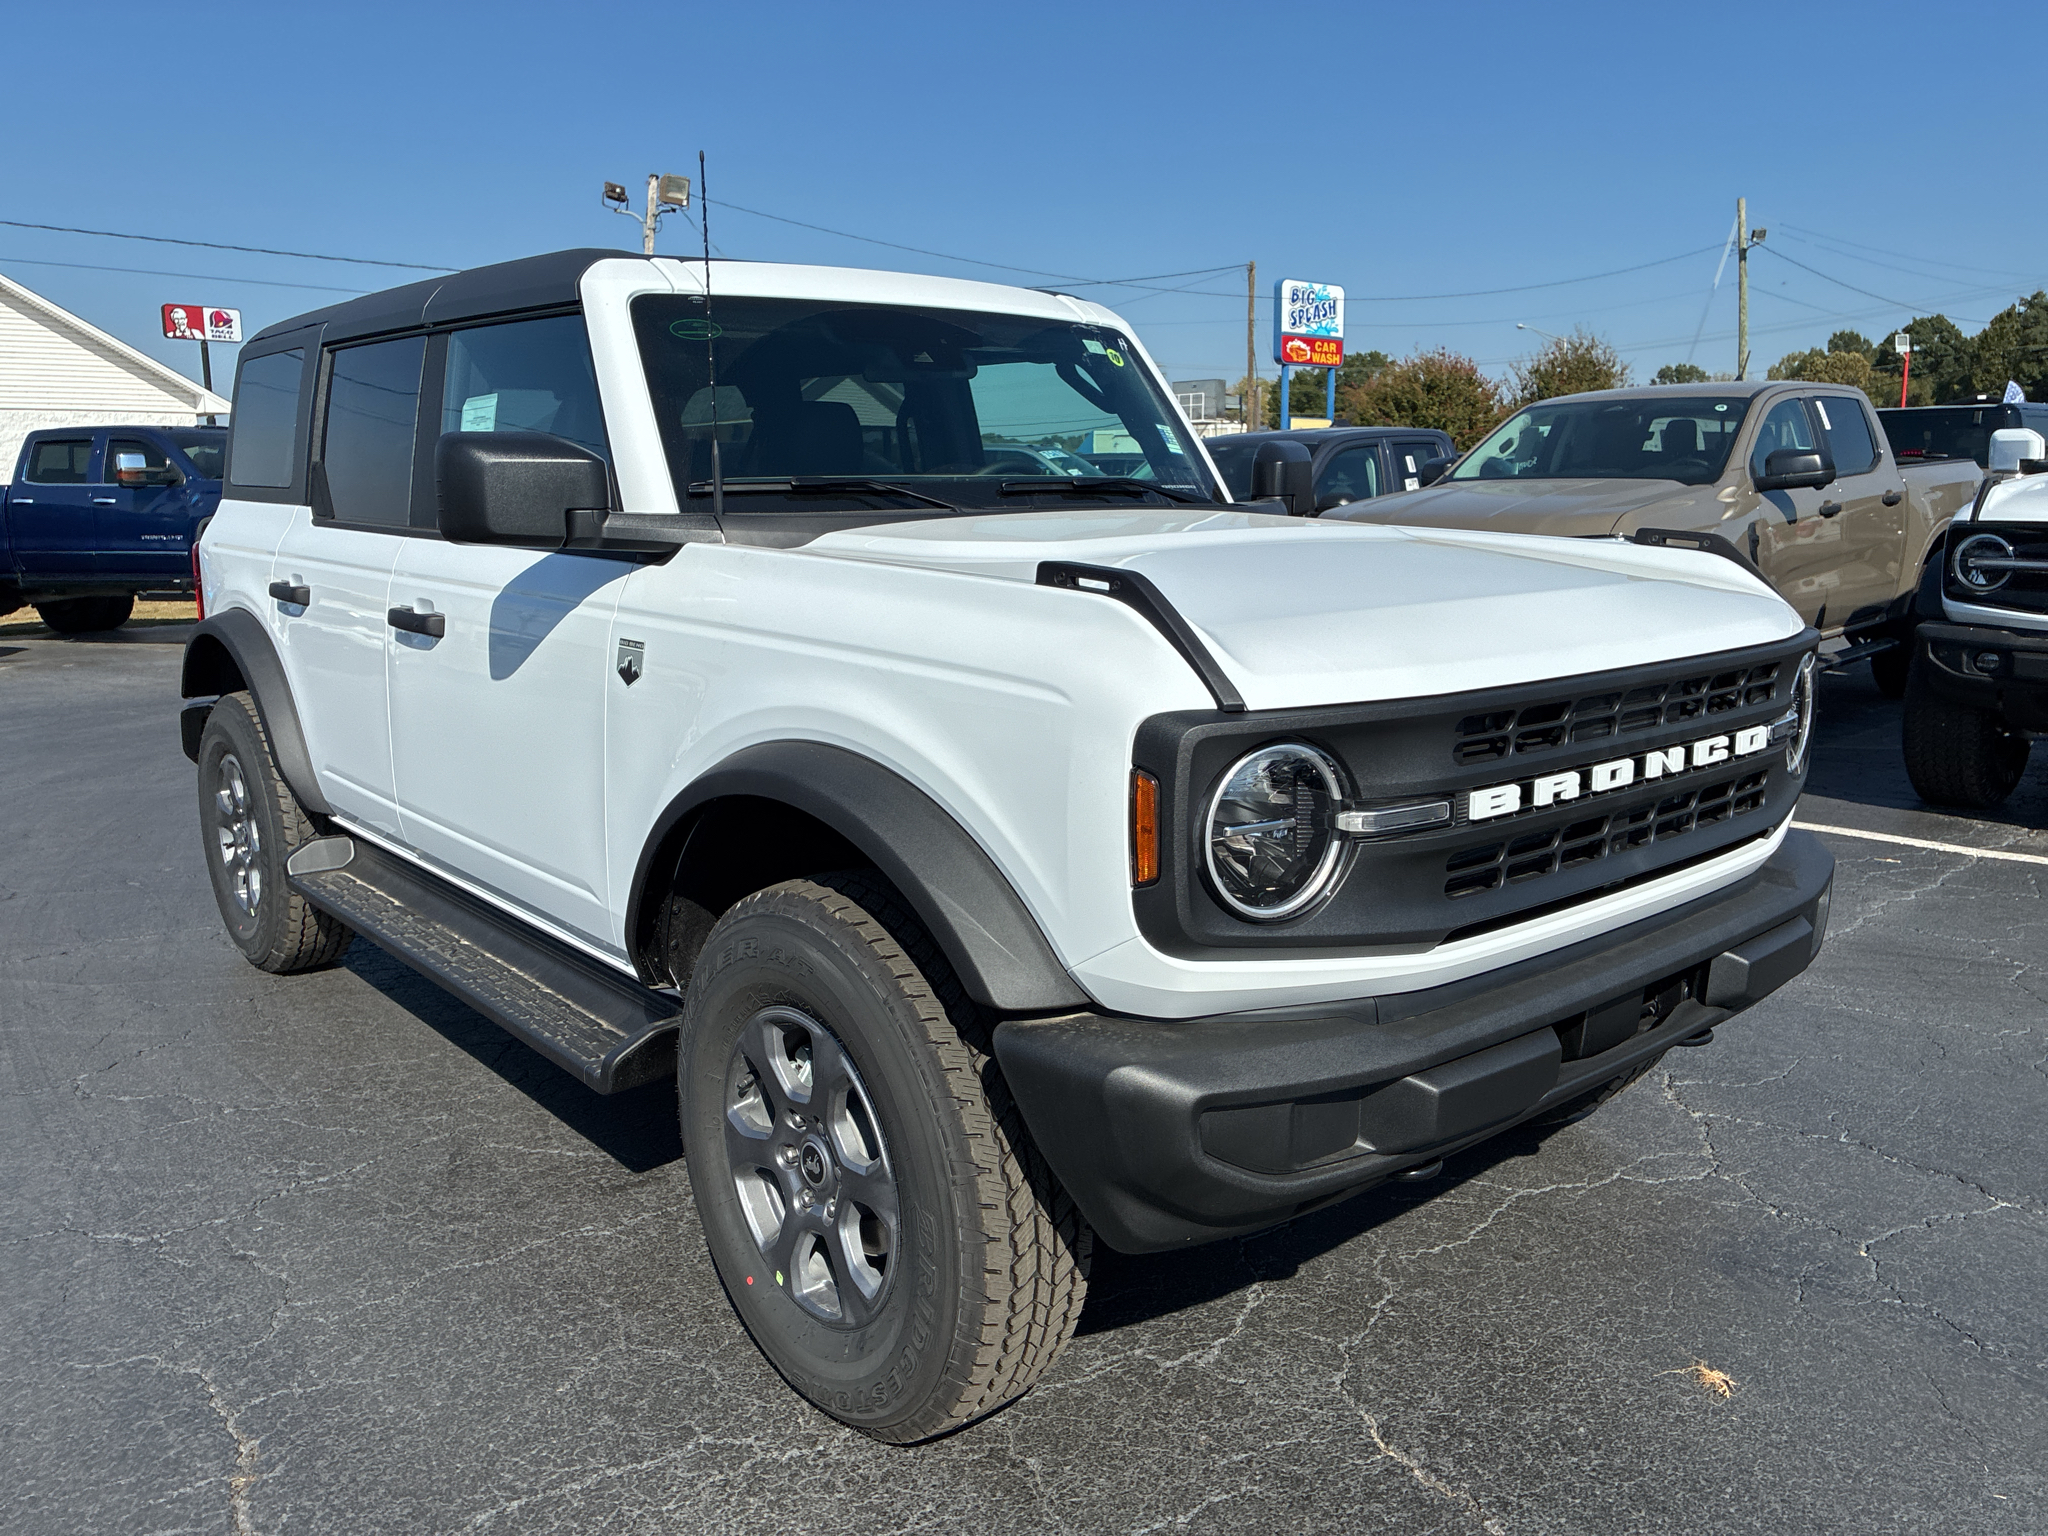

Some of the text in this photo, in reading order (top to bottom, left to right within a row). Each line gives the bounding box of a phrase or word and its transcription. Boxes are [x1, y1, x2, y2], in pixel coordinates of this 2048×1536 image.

[1291, 288, 1316, 306] BIG
[1290, 299, 1336, 327] SPLASH
[1314, 341, 1337, 353] CAR
[1312, 352, 1340, 365] WASH
[1468, 725, 1768, 821] BRONCO
